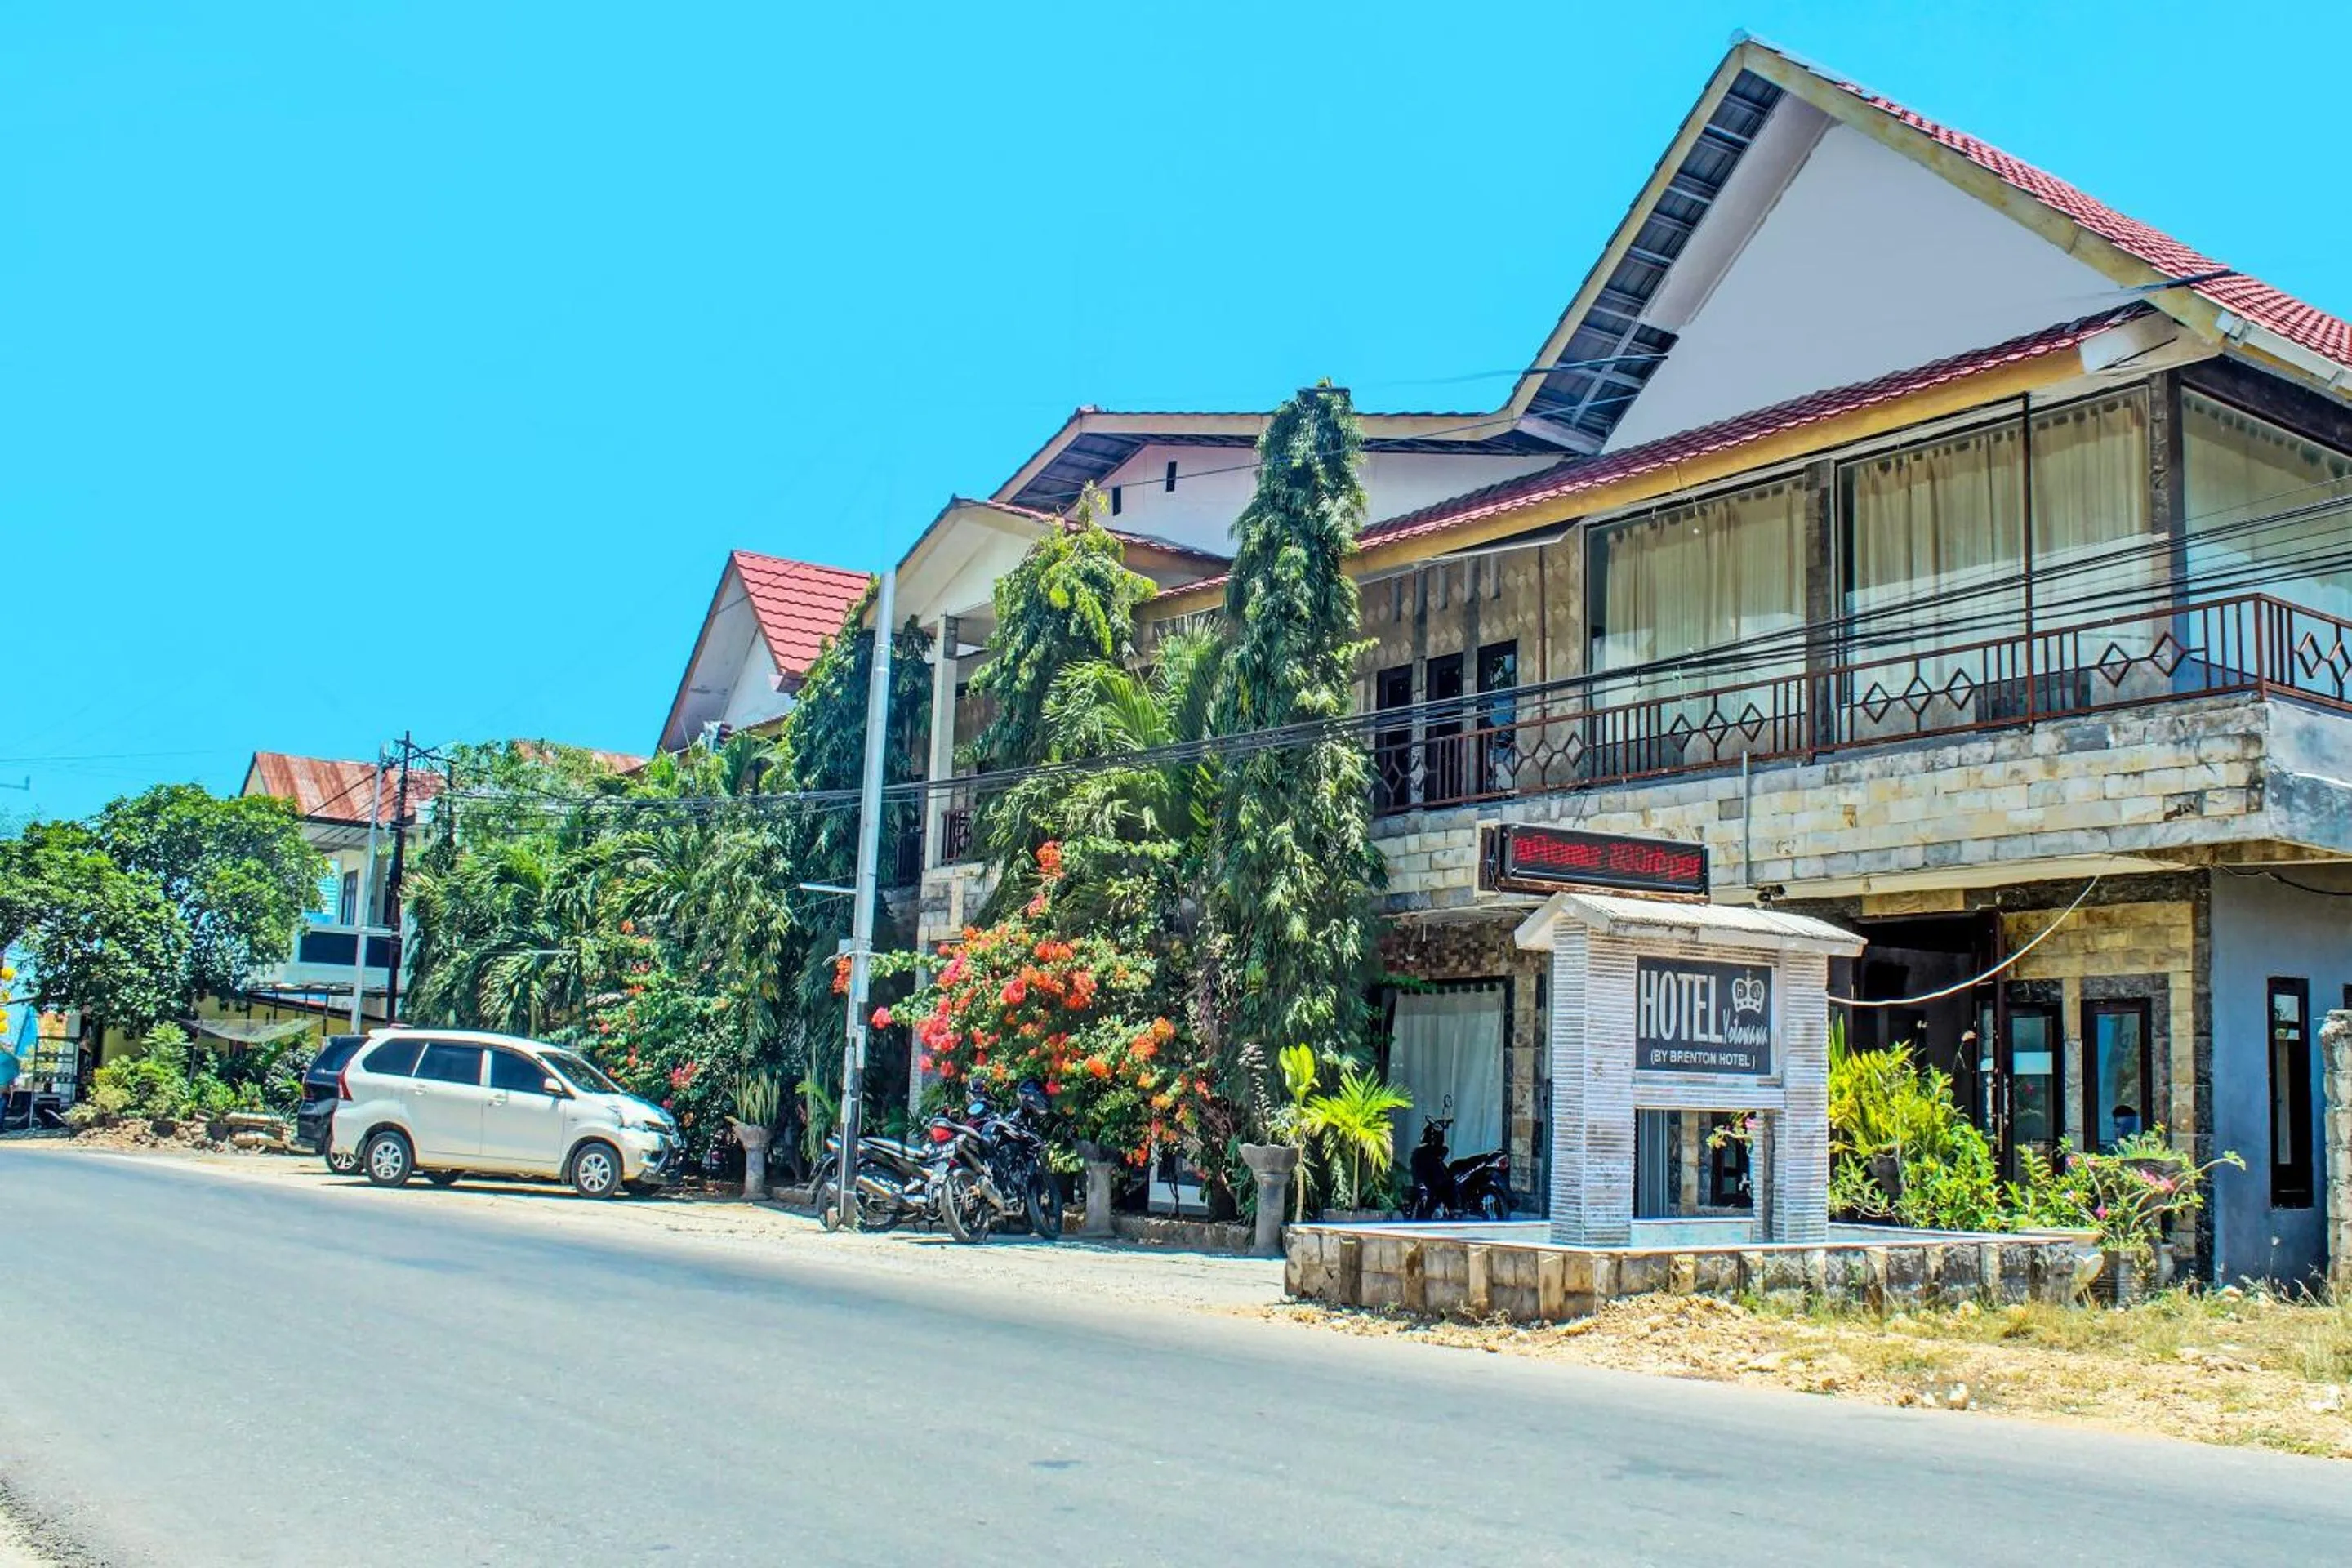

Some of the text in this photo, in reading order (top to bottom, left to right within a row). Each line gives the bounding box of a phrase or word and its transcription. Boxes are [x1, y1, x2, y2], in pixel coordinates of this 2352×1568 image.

[1639, 969, 1723, 1043] HOTEL
[1650, 1049, 1668, 1065] (BY
[1669, 1050, 1716, 1065] BRENTON
